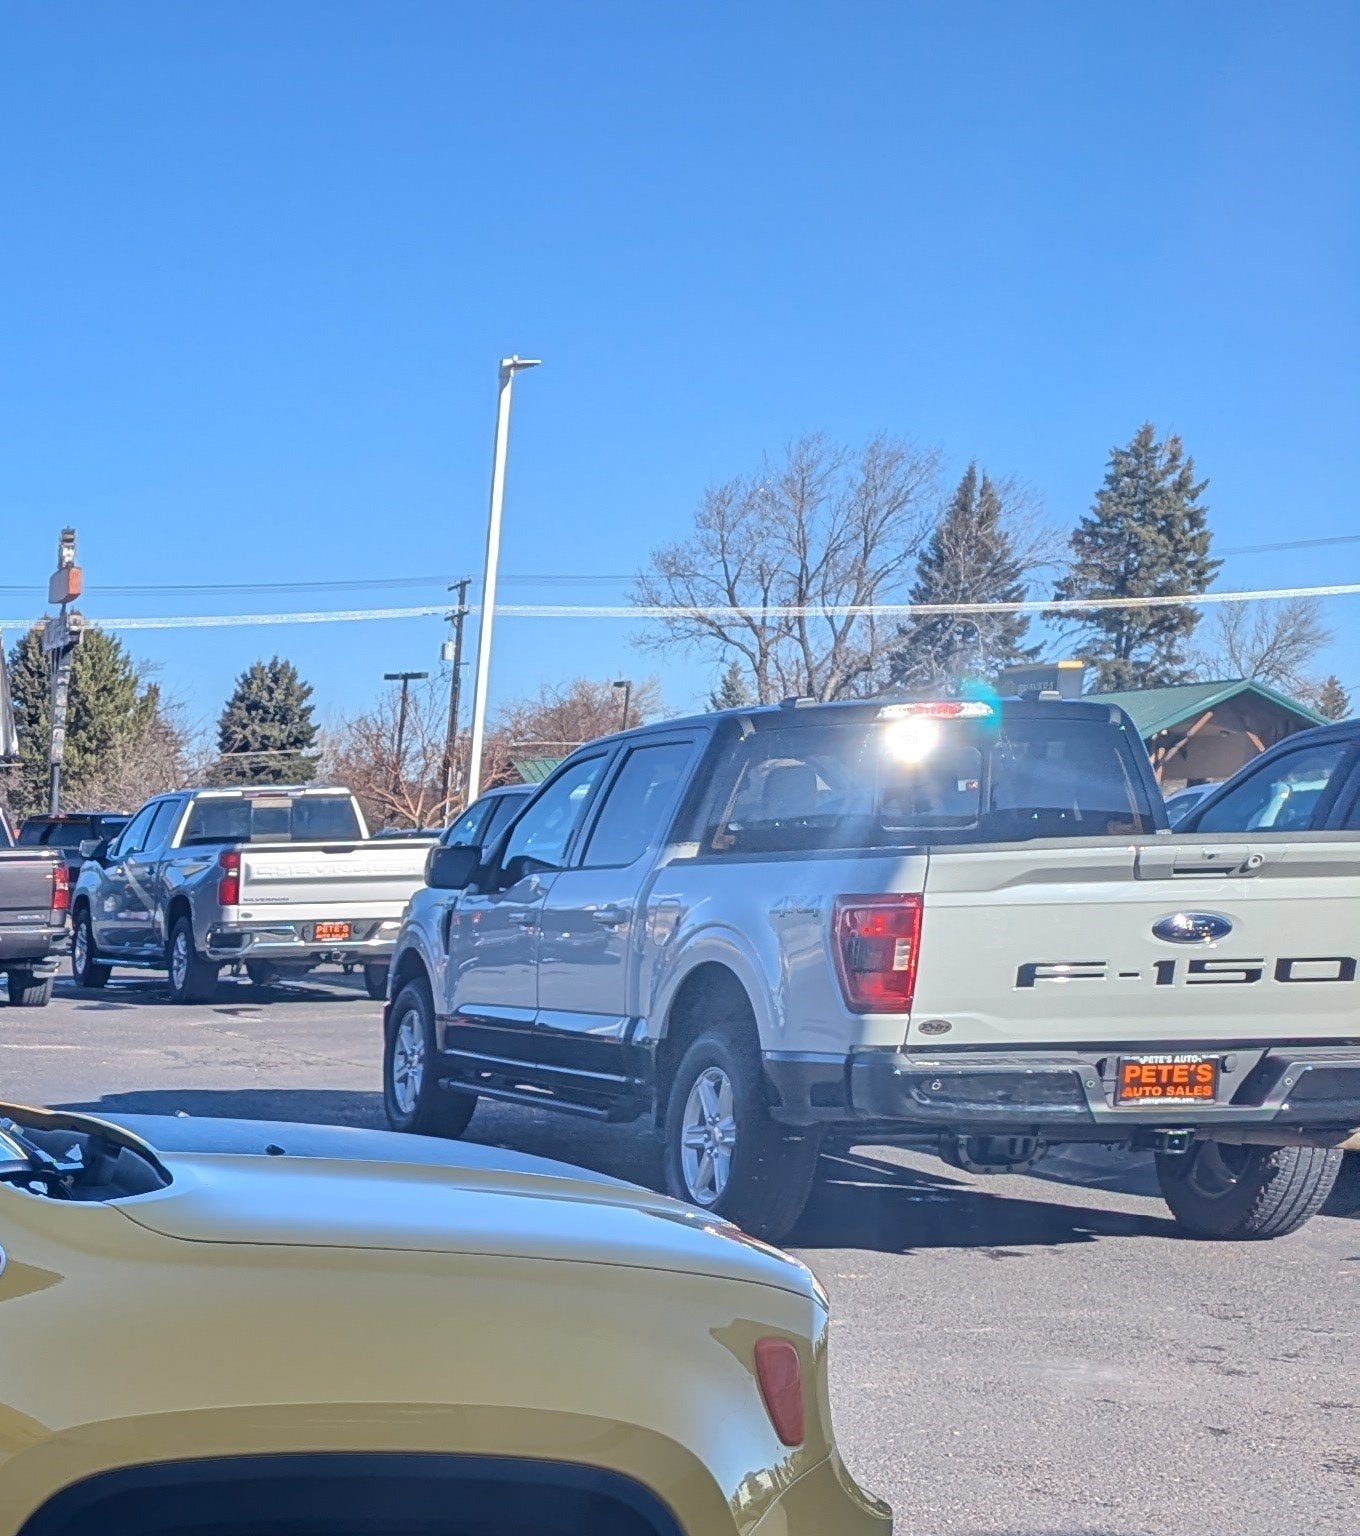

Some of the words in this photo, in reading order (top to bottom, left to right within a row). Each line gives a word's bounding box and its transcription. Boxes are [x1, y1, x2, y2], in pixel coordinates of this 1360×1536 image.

[1015, 956, 1357, 989] F-150
[1124, 1063, 1213, 1083] PETE'S
[1122, 1086, 1162, 1097] AUTO
[1166, 1085, 1212, 1096] SALES
